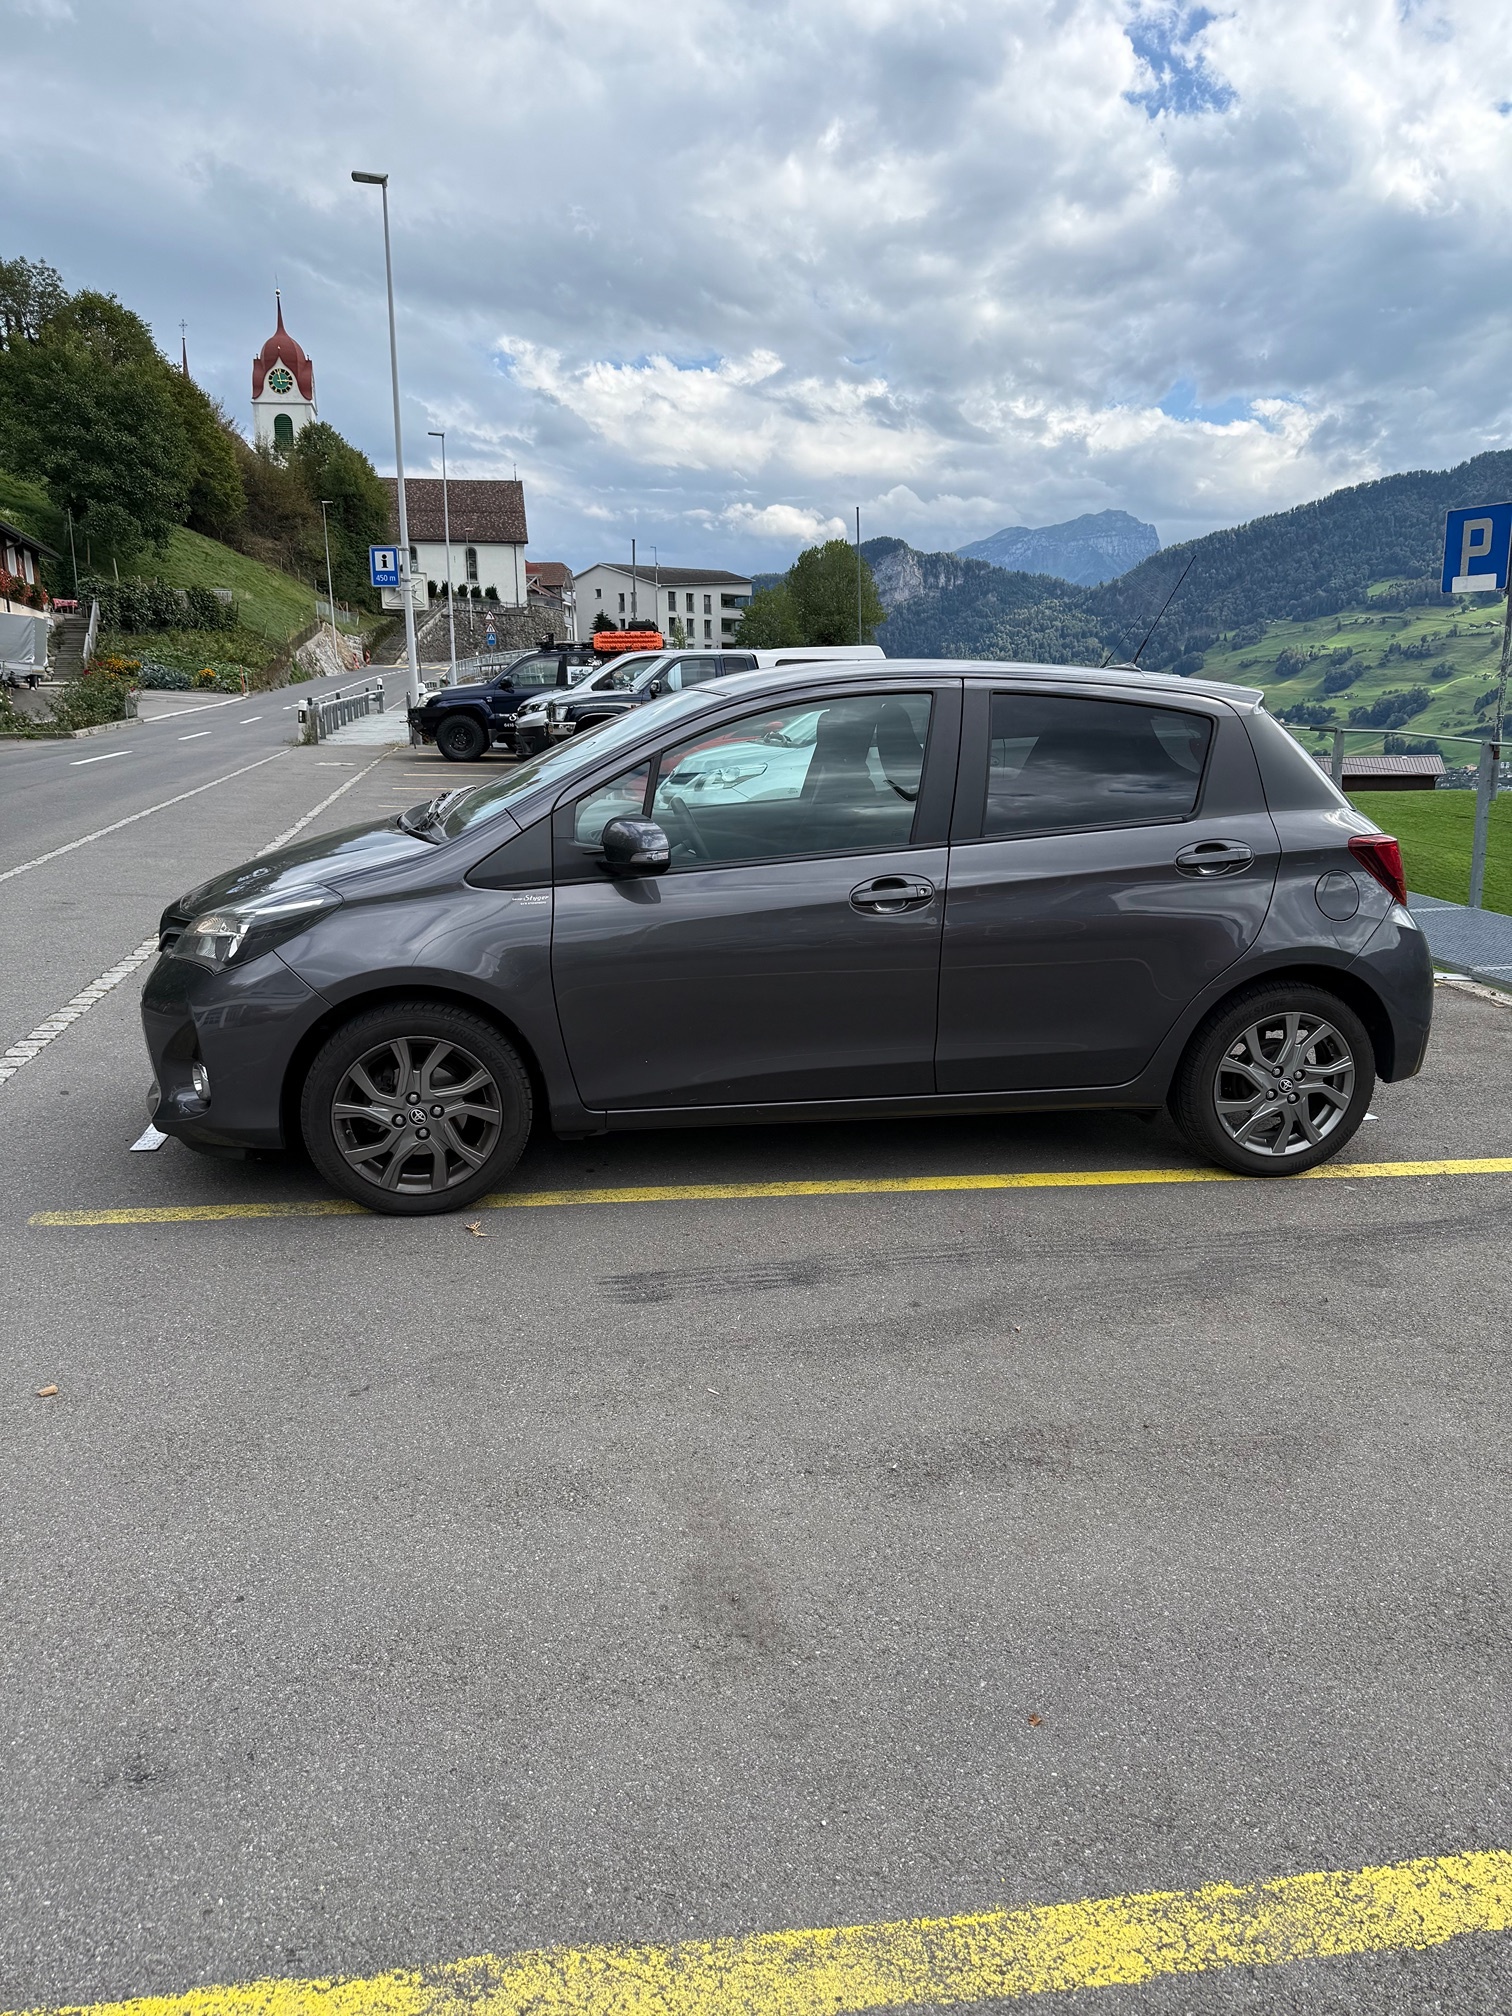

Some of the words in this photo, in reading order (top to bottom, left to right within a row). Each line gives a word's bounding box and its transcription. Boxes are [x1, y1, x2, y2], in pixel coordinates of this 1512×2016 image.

[1459, 517, 1494, 577] P
[376, 574, 388, 582] 450
[523, 894, 550, 902] Styger
[448, 1024, 512, 1083] BRIDGESTONE
